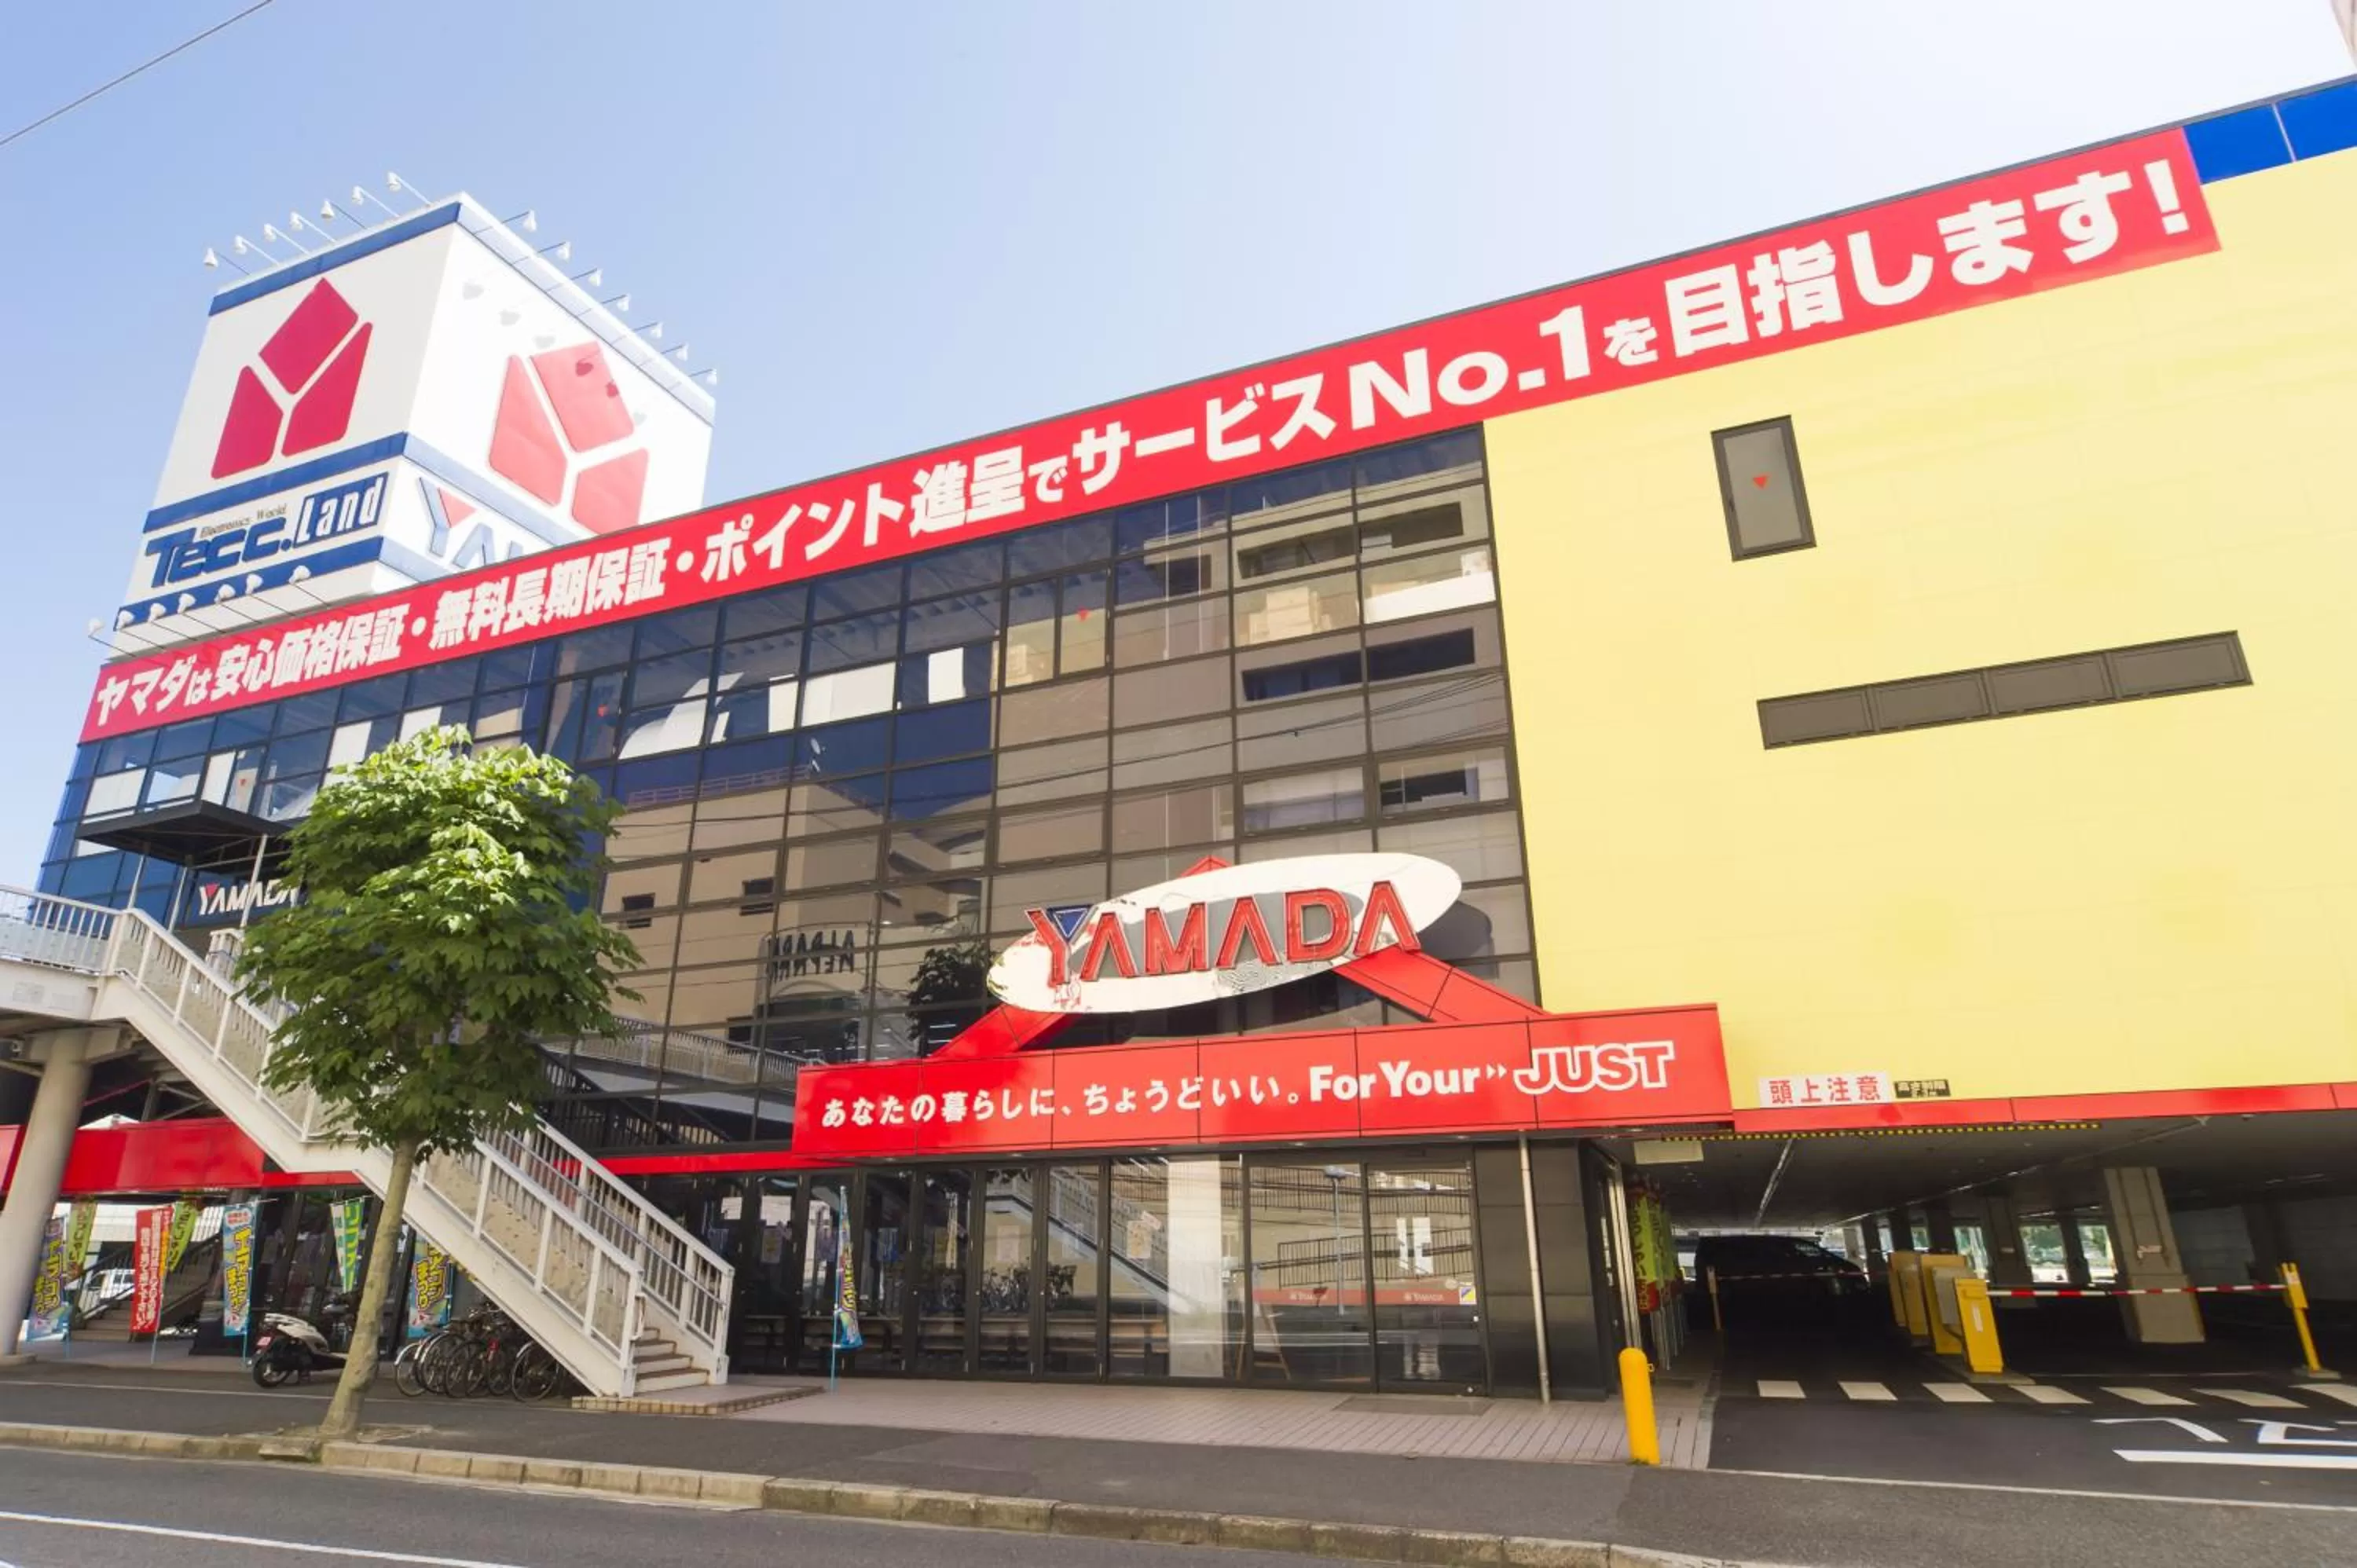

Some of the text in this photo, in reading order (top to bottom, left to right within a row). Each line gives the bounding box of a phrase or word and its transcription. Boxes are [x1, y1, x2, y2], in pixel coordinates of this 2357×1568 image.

[1025, 880, 1421, 987] YAMADA
[822, 1075, 1298, 1128] あなたの暮らしに、ちょうどいい。
[1513, 1040, 1675, 1095] JUST
[1769, 1075, 1881, 1104] 頭上注意
